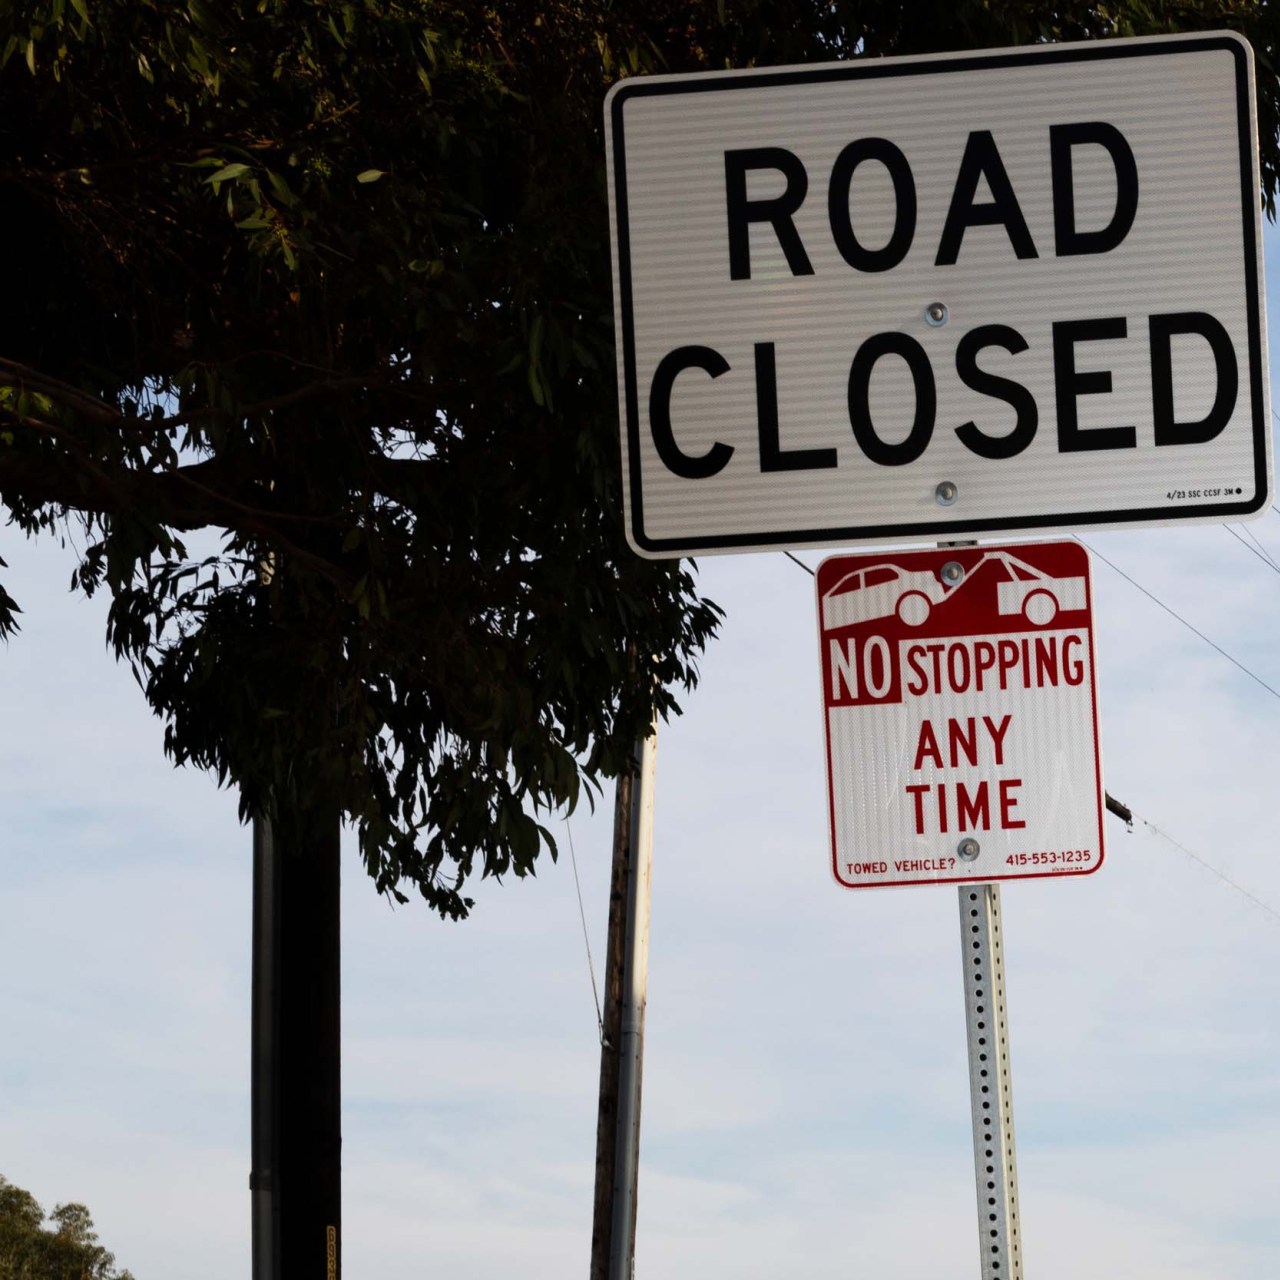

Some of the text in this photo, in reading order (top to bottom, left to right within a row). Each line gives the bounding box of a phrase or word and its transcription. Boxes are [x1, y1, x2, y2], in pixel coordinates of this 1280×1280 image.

[724, 122, 1138, 280] ROAD
[649, 312, 1238, 479] CLOSED
[1166, 489, 1186, 501] 4/23
[830, 635, 1084, 700] NO STOPPING
[914, 715, 1012, 770] ANY
[906, 779, 1026, 834] TIME
[847, 857, 956, 874] TOWED VEHICLE?
[1005, 850, 1091, 866] 415-553-1235
